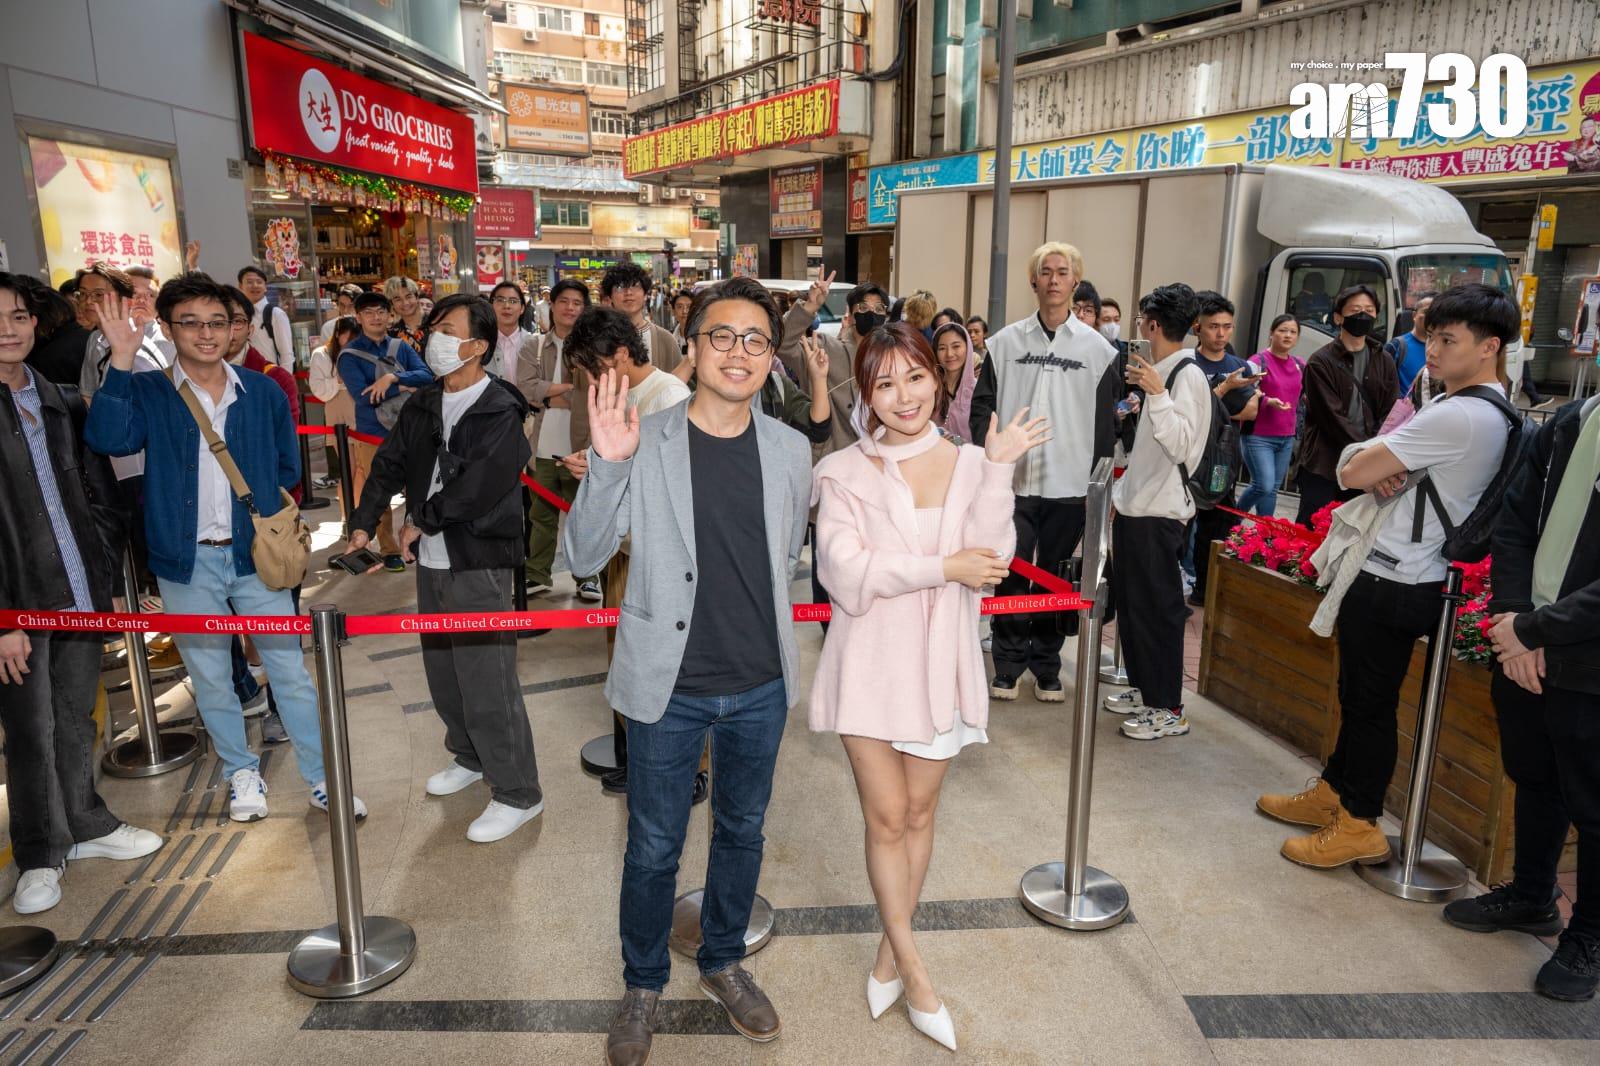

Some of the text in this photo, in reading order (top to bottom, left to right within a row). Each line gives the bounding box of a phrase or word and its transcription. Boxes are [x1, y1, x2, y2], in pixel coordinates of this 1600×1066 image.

[307, 91, 336, 132] 大生
[341, 89, 454, 151] DS GROCERIES
[345, 126, 455, 173] Great variety quality deals
[483, 206, 514, 214] HANG
[80, 231, 154, 256] 環球食品
[1008, 598, 1046, 609] United
[17, 614, 150, 629] China United Centre
[205, 619, 243, 631] China
[246, 619, 290, 631] United
[400, 616, 532, 630] China United Centre
